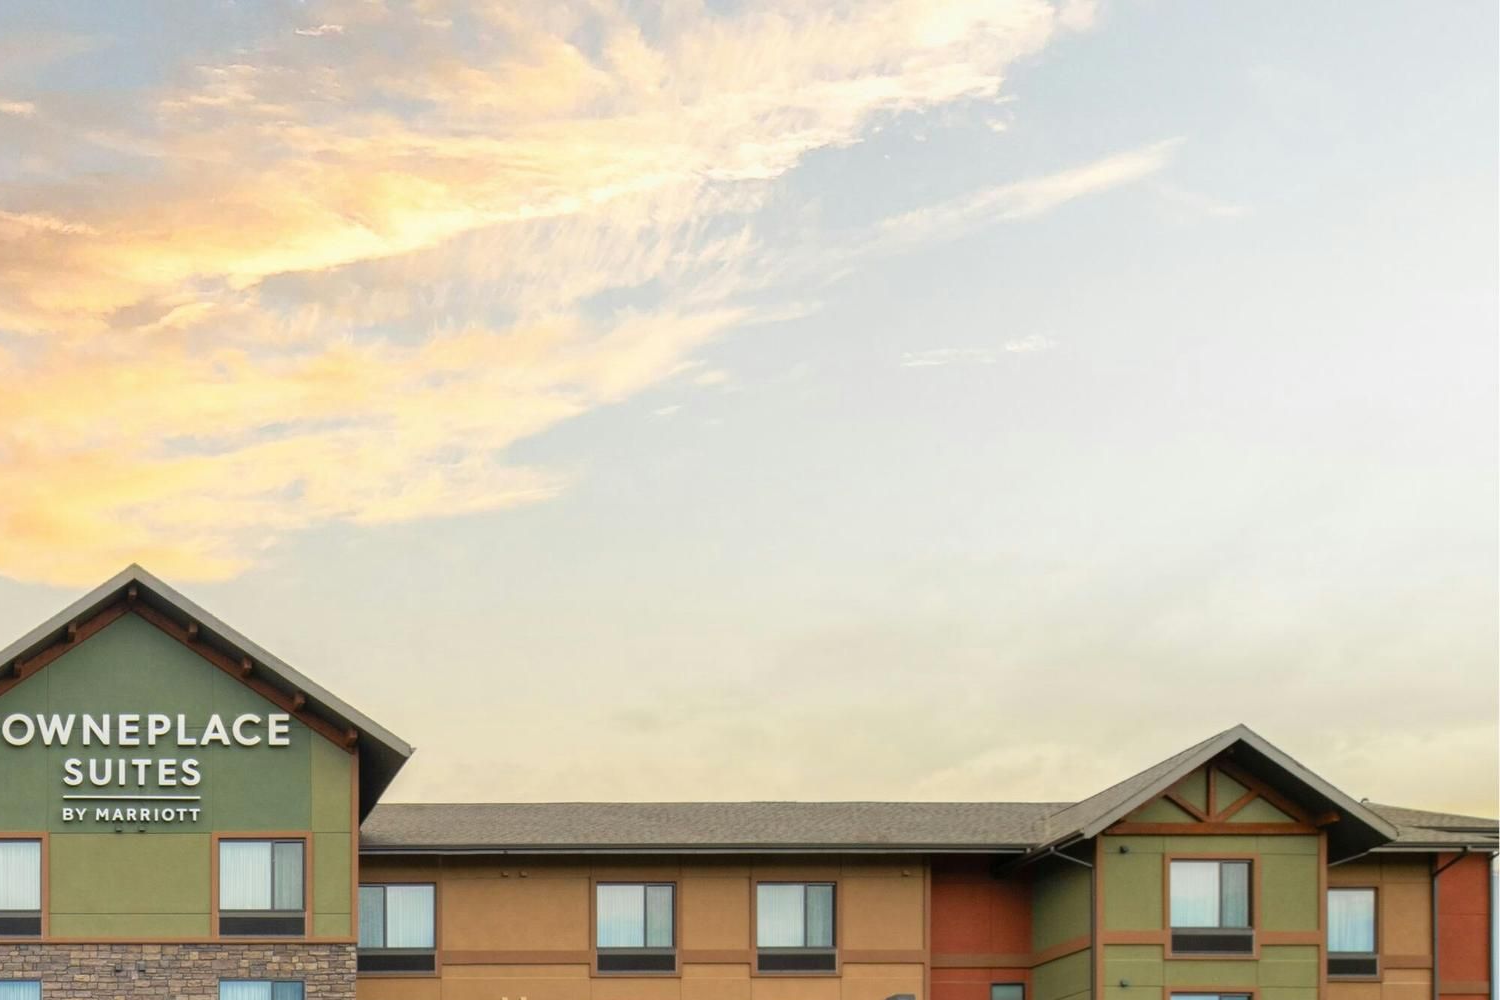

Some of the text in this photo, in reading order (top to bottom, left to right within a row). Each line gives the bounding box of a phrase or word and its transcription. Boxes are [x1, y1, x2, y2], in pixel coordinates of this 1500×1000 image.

[63, 758, 201, 786] SUITES
[62, 807, 201, 822] BY MARRIOTT
